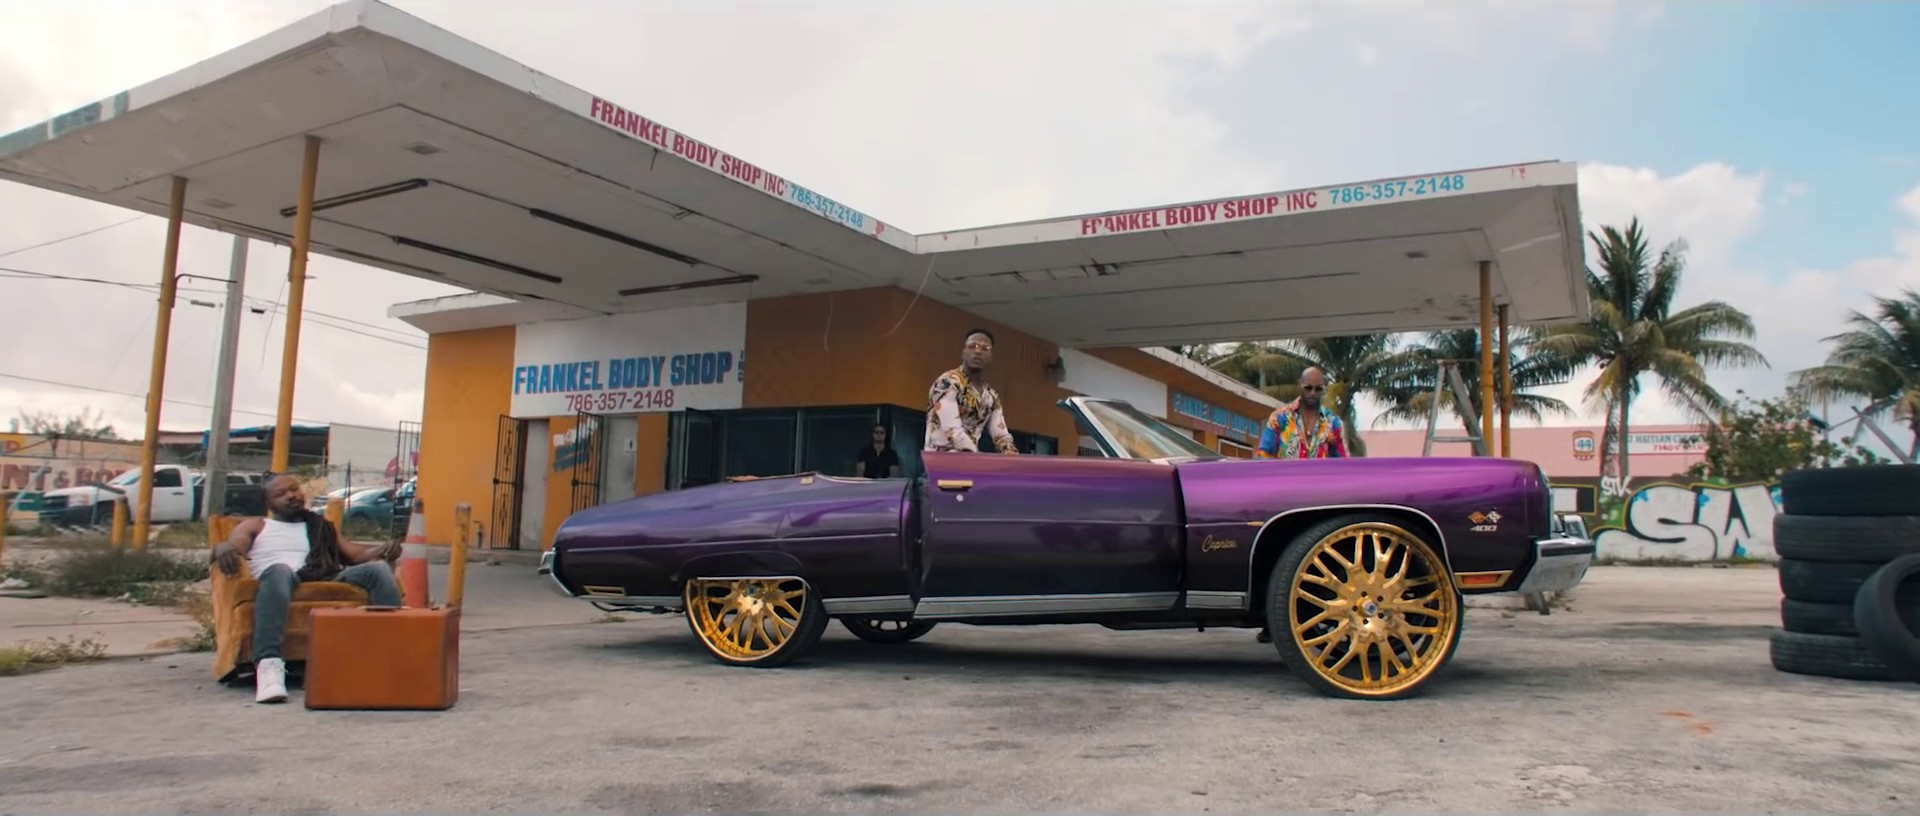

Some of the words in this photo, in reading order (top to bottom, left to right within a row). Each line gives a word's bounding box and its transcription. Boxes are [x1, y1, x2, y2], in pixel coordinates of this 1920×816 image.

[591, 96, 668, 148] FRANKEL
[673, 134, 718, 167] BODY
[721, 154, 762, 184] SHOP
[764, 172, 784, 195] INC
[791, 185, 863, 227] 786-357-2148
[1165, 203, 1218, 225] BODY
[1223, 196, 1279, 218] SHOP
[1286, 191, 1318, 212] INC
[1329, 174, 1465, 204] 786-357-2148
[514, 360, 603, 395] FRANKEL
[608, 356, 665, 389] BODY
[670, 351, 732, 385] SHOP
[565, 389, 674, 412] 786-357-2148
[1577, 439, 1592, 449] 44
